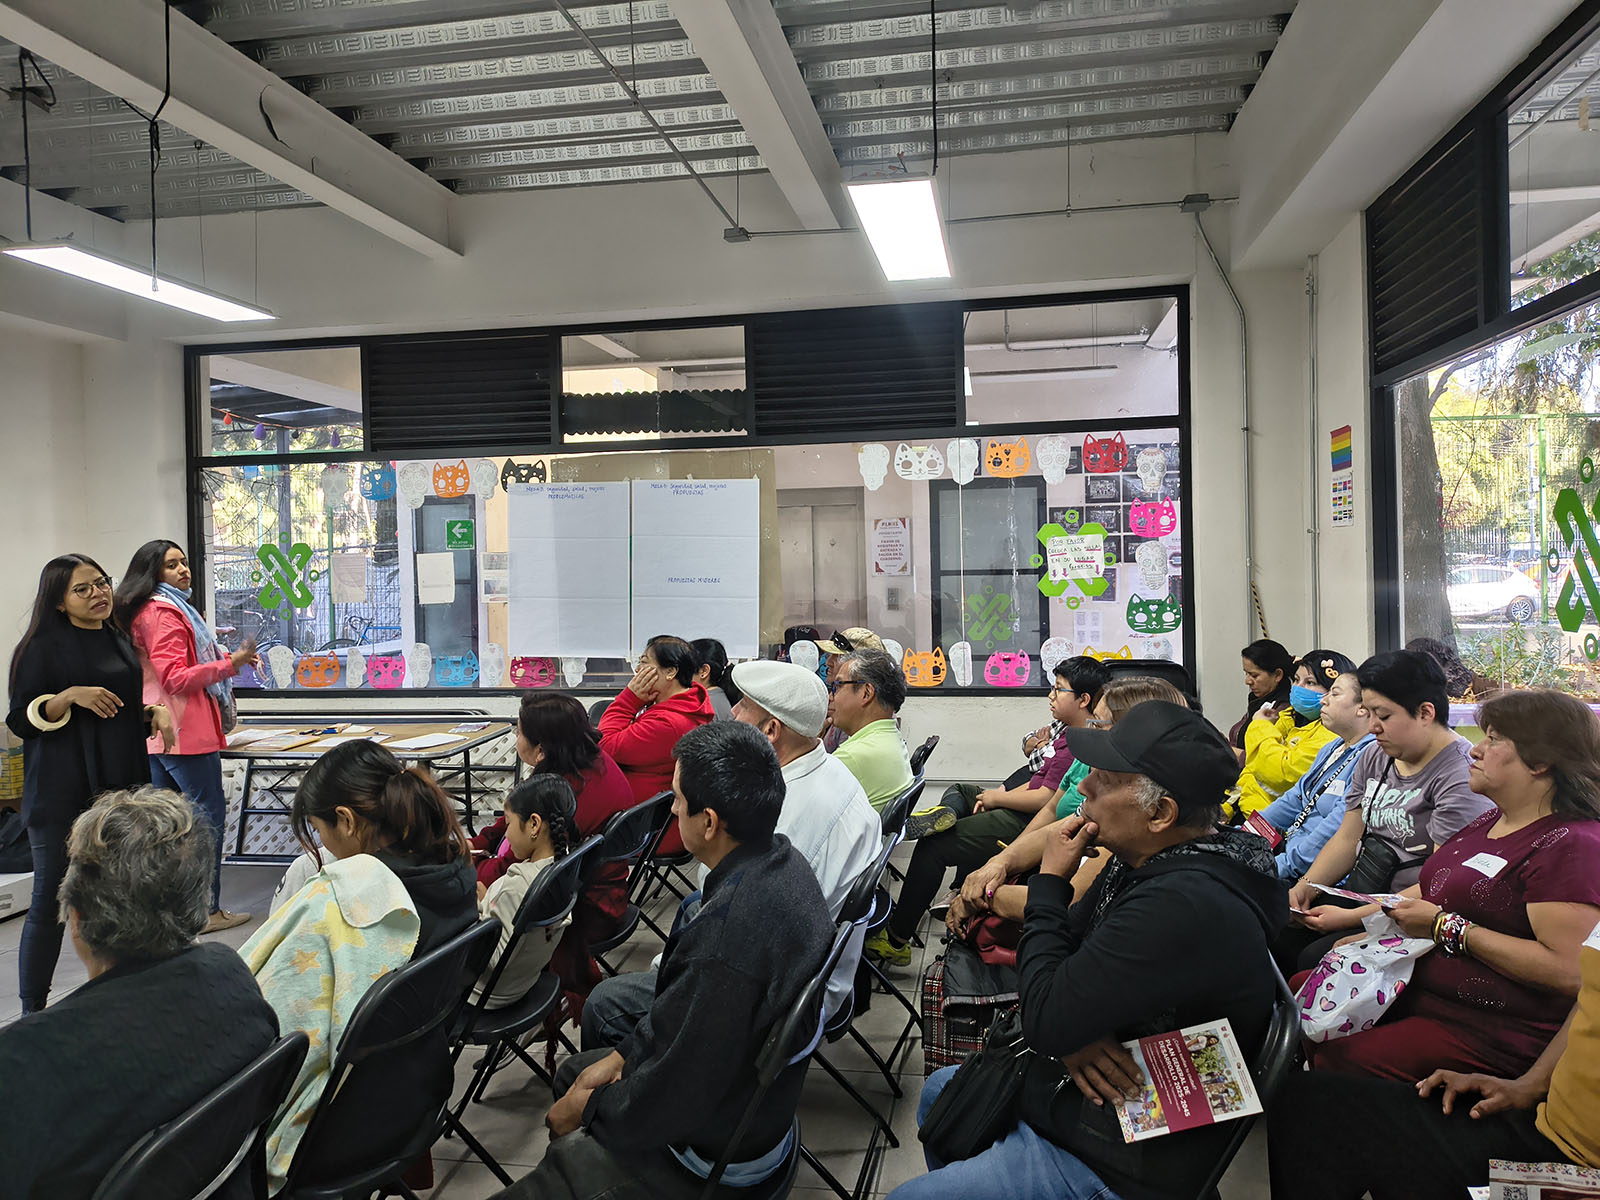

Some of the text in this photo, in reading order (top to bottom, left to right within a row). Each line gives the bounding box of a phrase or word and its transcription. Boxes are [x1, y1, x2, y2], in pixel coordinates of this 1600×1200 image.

[1066, 537, 1085, 545] FAVOR
[1159, 1040, 1178, 1081] DESARROLLO
[1174, 1081, 1191, 1117] 2025-2045
[1165, 1039, 1191, 1095] PLAN GENERAL DE
